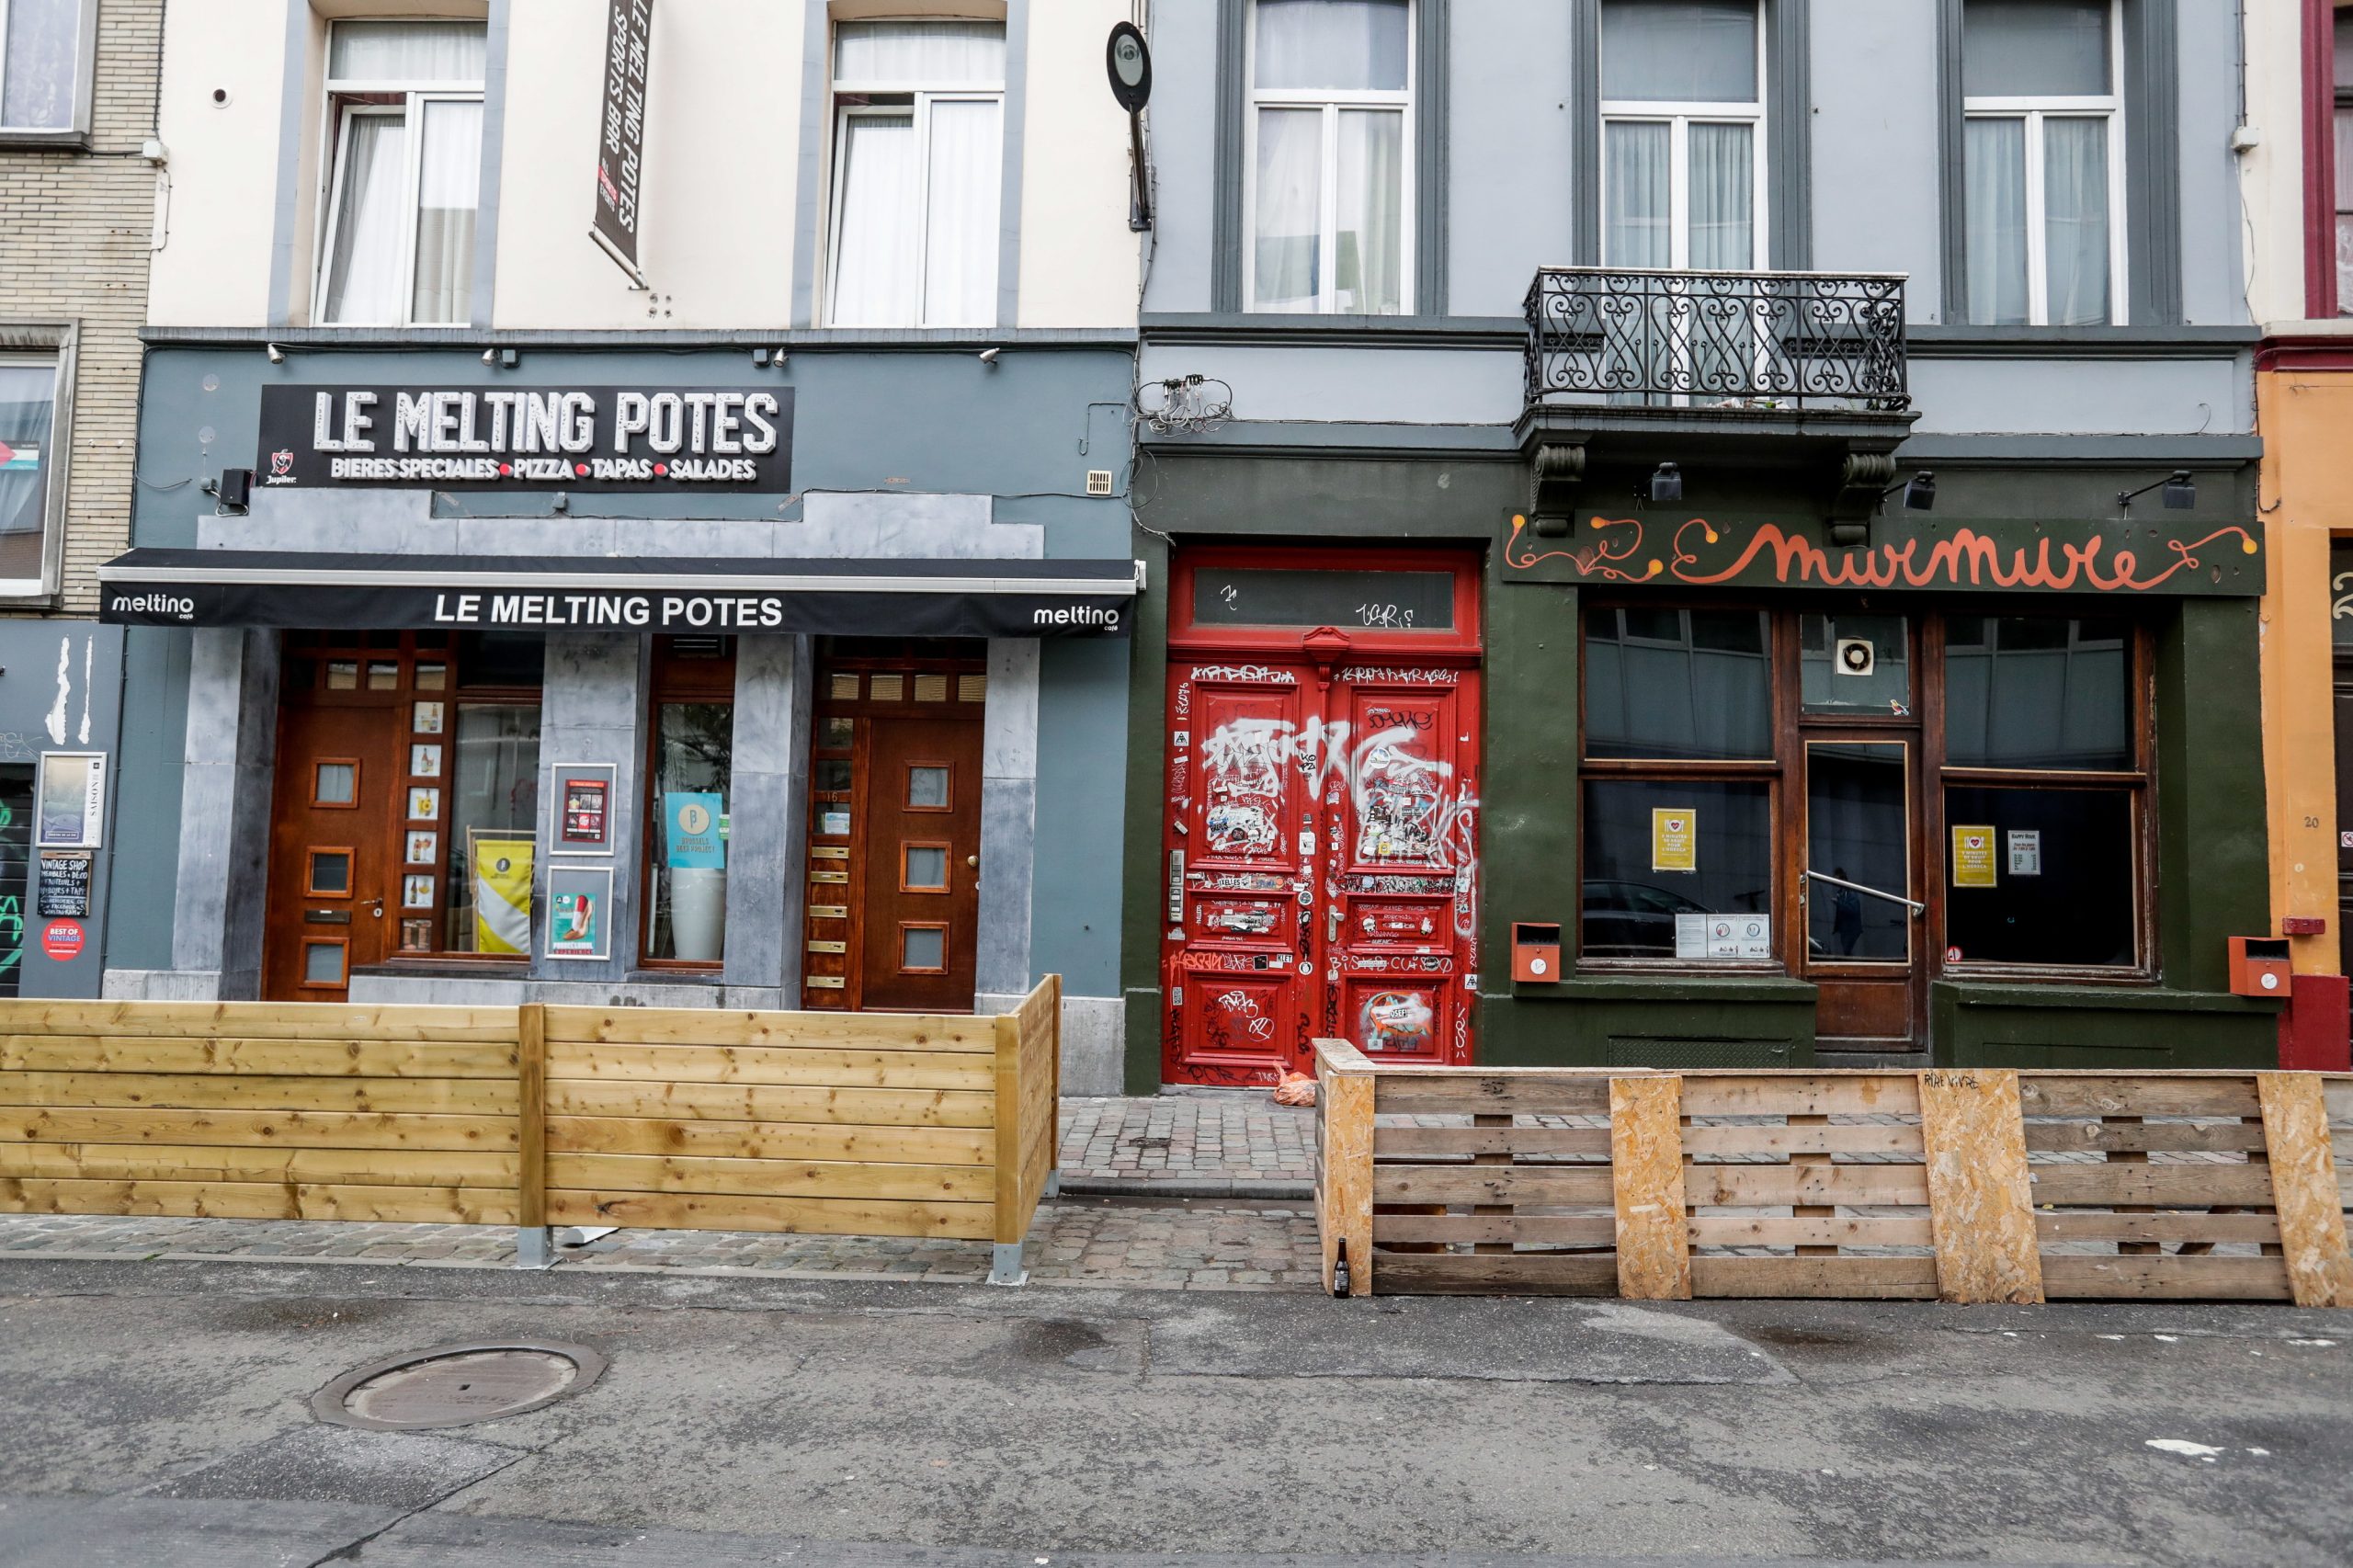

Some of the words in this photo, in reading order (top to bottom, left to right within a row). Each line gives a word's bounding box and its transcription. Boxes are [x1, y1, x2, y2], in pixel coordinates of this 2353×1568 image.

[609, 6, 628, 103] SPORTS
[606, 99, 622, 154] BAR
[619, 142, 639, 233] POTES
[313, 392, 378, 452] LE
[393, 392, 596, 453] MELTING
[613, 392, 779, 454] POTES
[331, 458, 398, 480] BIERES
[398, 458, 500, 481] SPECIALES
[514, 458, 576, 481] PIZZA
[591, 458, 655, 482] TAPAS
[669, 459, 757, 483] SALADES
[111, 593, 195, 613] meltino
[435, 594, 481, 622] LE
[491, 595, 650, 625] MELTING
[662, 597, 783, 627] POTES
[1033, 606, 1120, 625] meltino
[90, 781, 99, 817] SAISON
[827, 791, 838, 802] 16
[2304, 815, 2319, 828] 20
[40, 859, 68, 870] VINTAGE
[69, 859, 87, 871] SHOP
[1219, 878, 1241, 886] IXELLES
